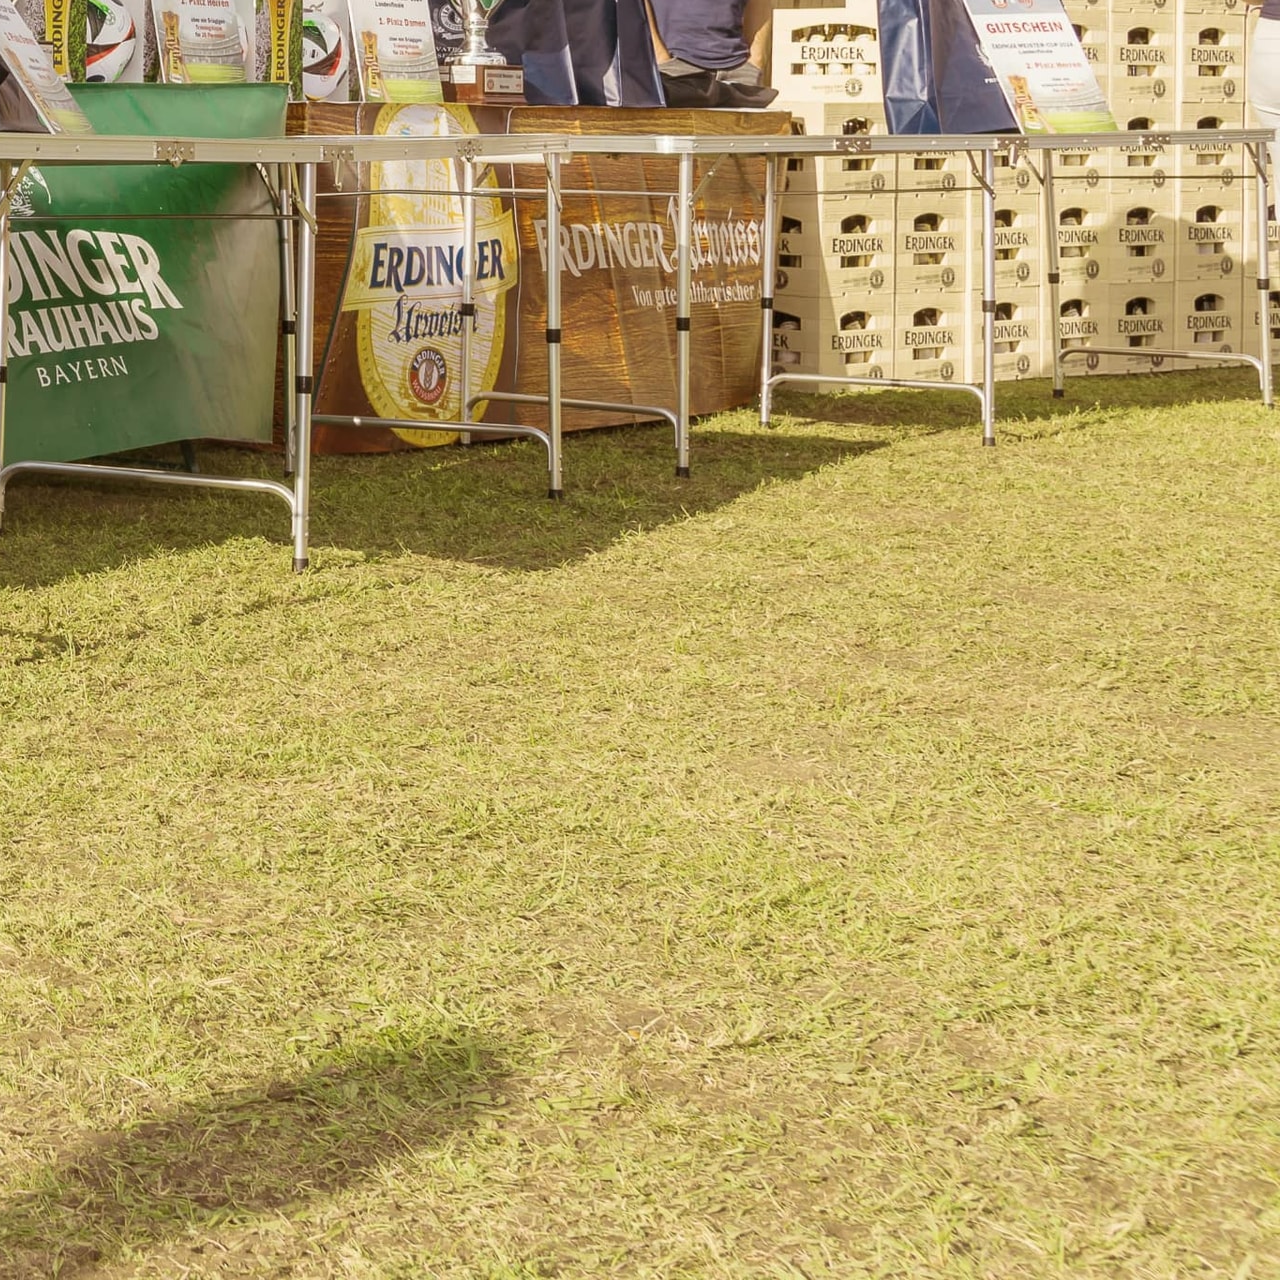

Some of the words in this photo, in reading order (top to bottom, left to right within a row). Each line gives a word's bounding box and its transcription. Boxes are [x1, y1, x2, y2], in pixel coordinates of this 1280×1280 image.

[986, 22, 1064, 34] GUTSCHEIN
[801, 45, 864, 61] ERDINGER
[1120, 48, 1167, 64] ERDINGER
[1191, 48, 1235, 64] ERDINGER
[1119, 228, 1165, 243] ERDINGER
[832, 238, 884, 255] ERDINGER
[905, 236, 955, 252] ERDINGER
[632, 284, 653, 307] Von
[1118, 319, 1164, 334] ERDINGER
[1187, 315, 1232, 331] ERDINGER
[831, 334, 883, 351] ERDINGER
[37, 355, 128, 387] BAYERN
